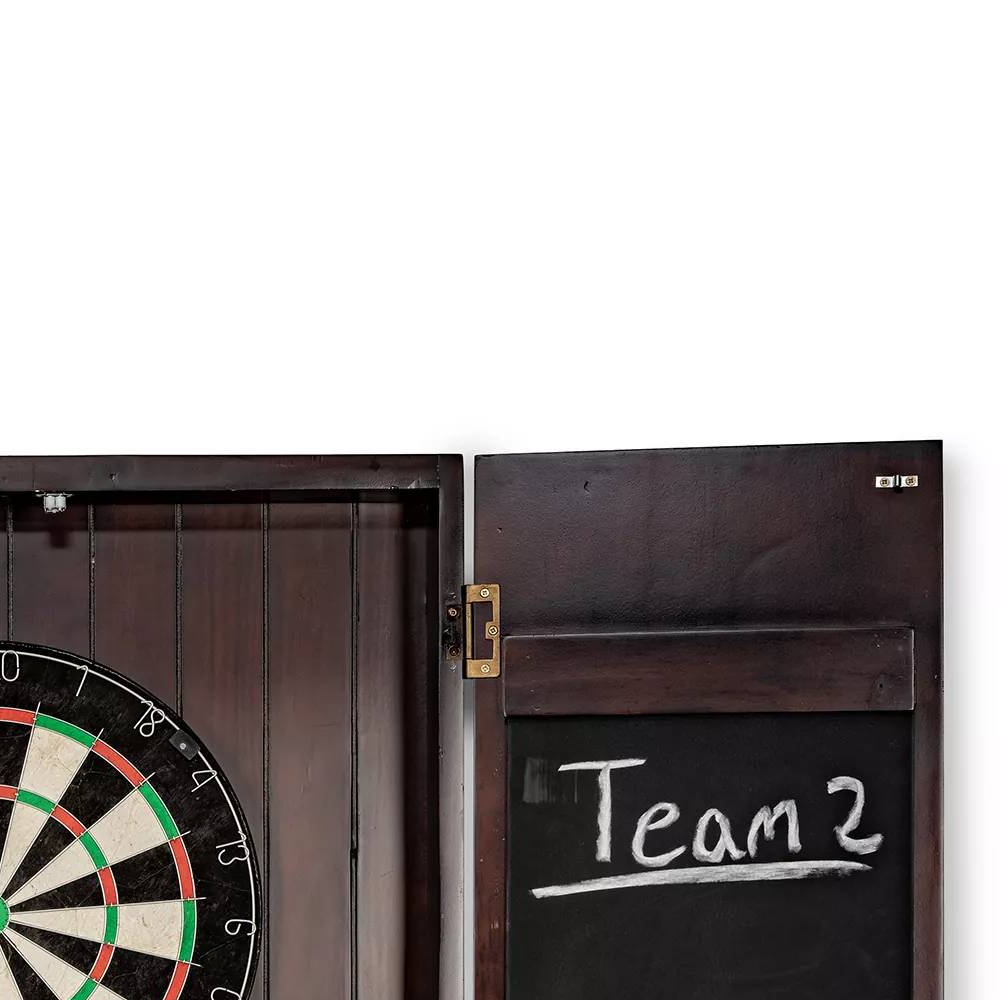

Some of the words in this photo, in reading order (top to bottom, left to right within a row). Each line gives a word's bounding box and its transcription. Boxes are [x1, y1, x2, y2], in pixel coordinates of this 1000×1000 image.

[191, 769, 217, 792] 4
[557, 758, 802, 868] Team
[826, 775, 884, 855] 2
[216, 830, 250, 865] 13
